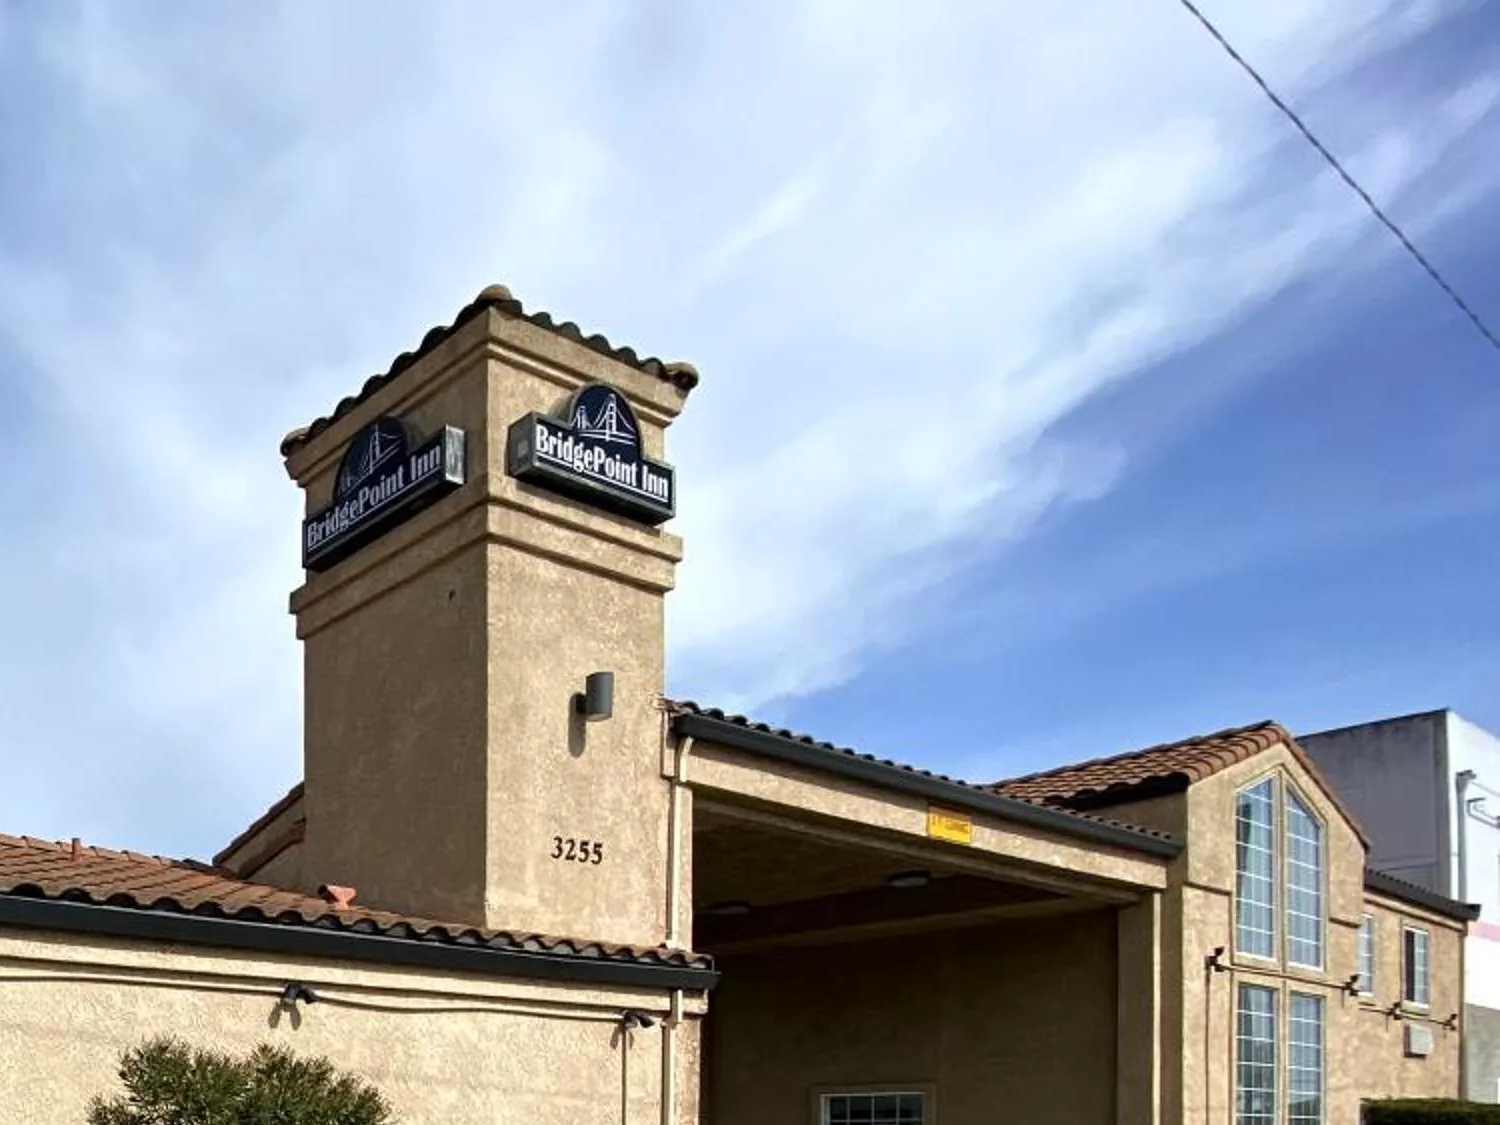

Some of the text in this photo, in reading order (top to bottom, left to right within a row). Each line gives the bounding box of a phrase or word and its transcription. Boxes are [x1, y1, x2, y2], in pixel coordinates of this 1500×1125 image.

[307, 444, 442, 543] BridgePoint Inn
[535, 424, 670, 502] BridgePoint Inn
[550, 835, 604, 865] 3255
